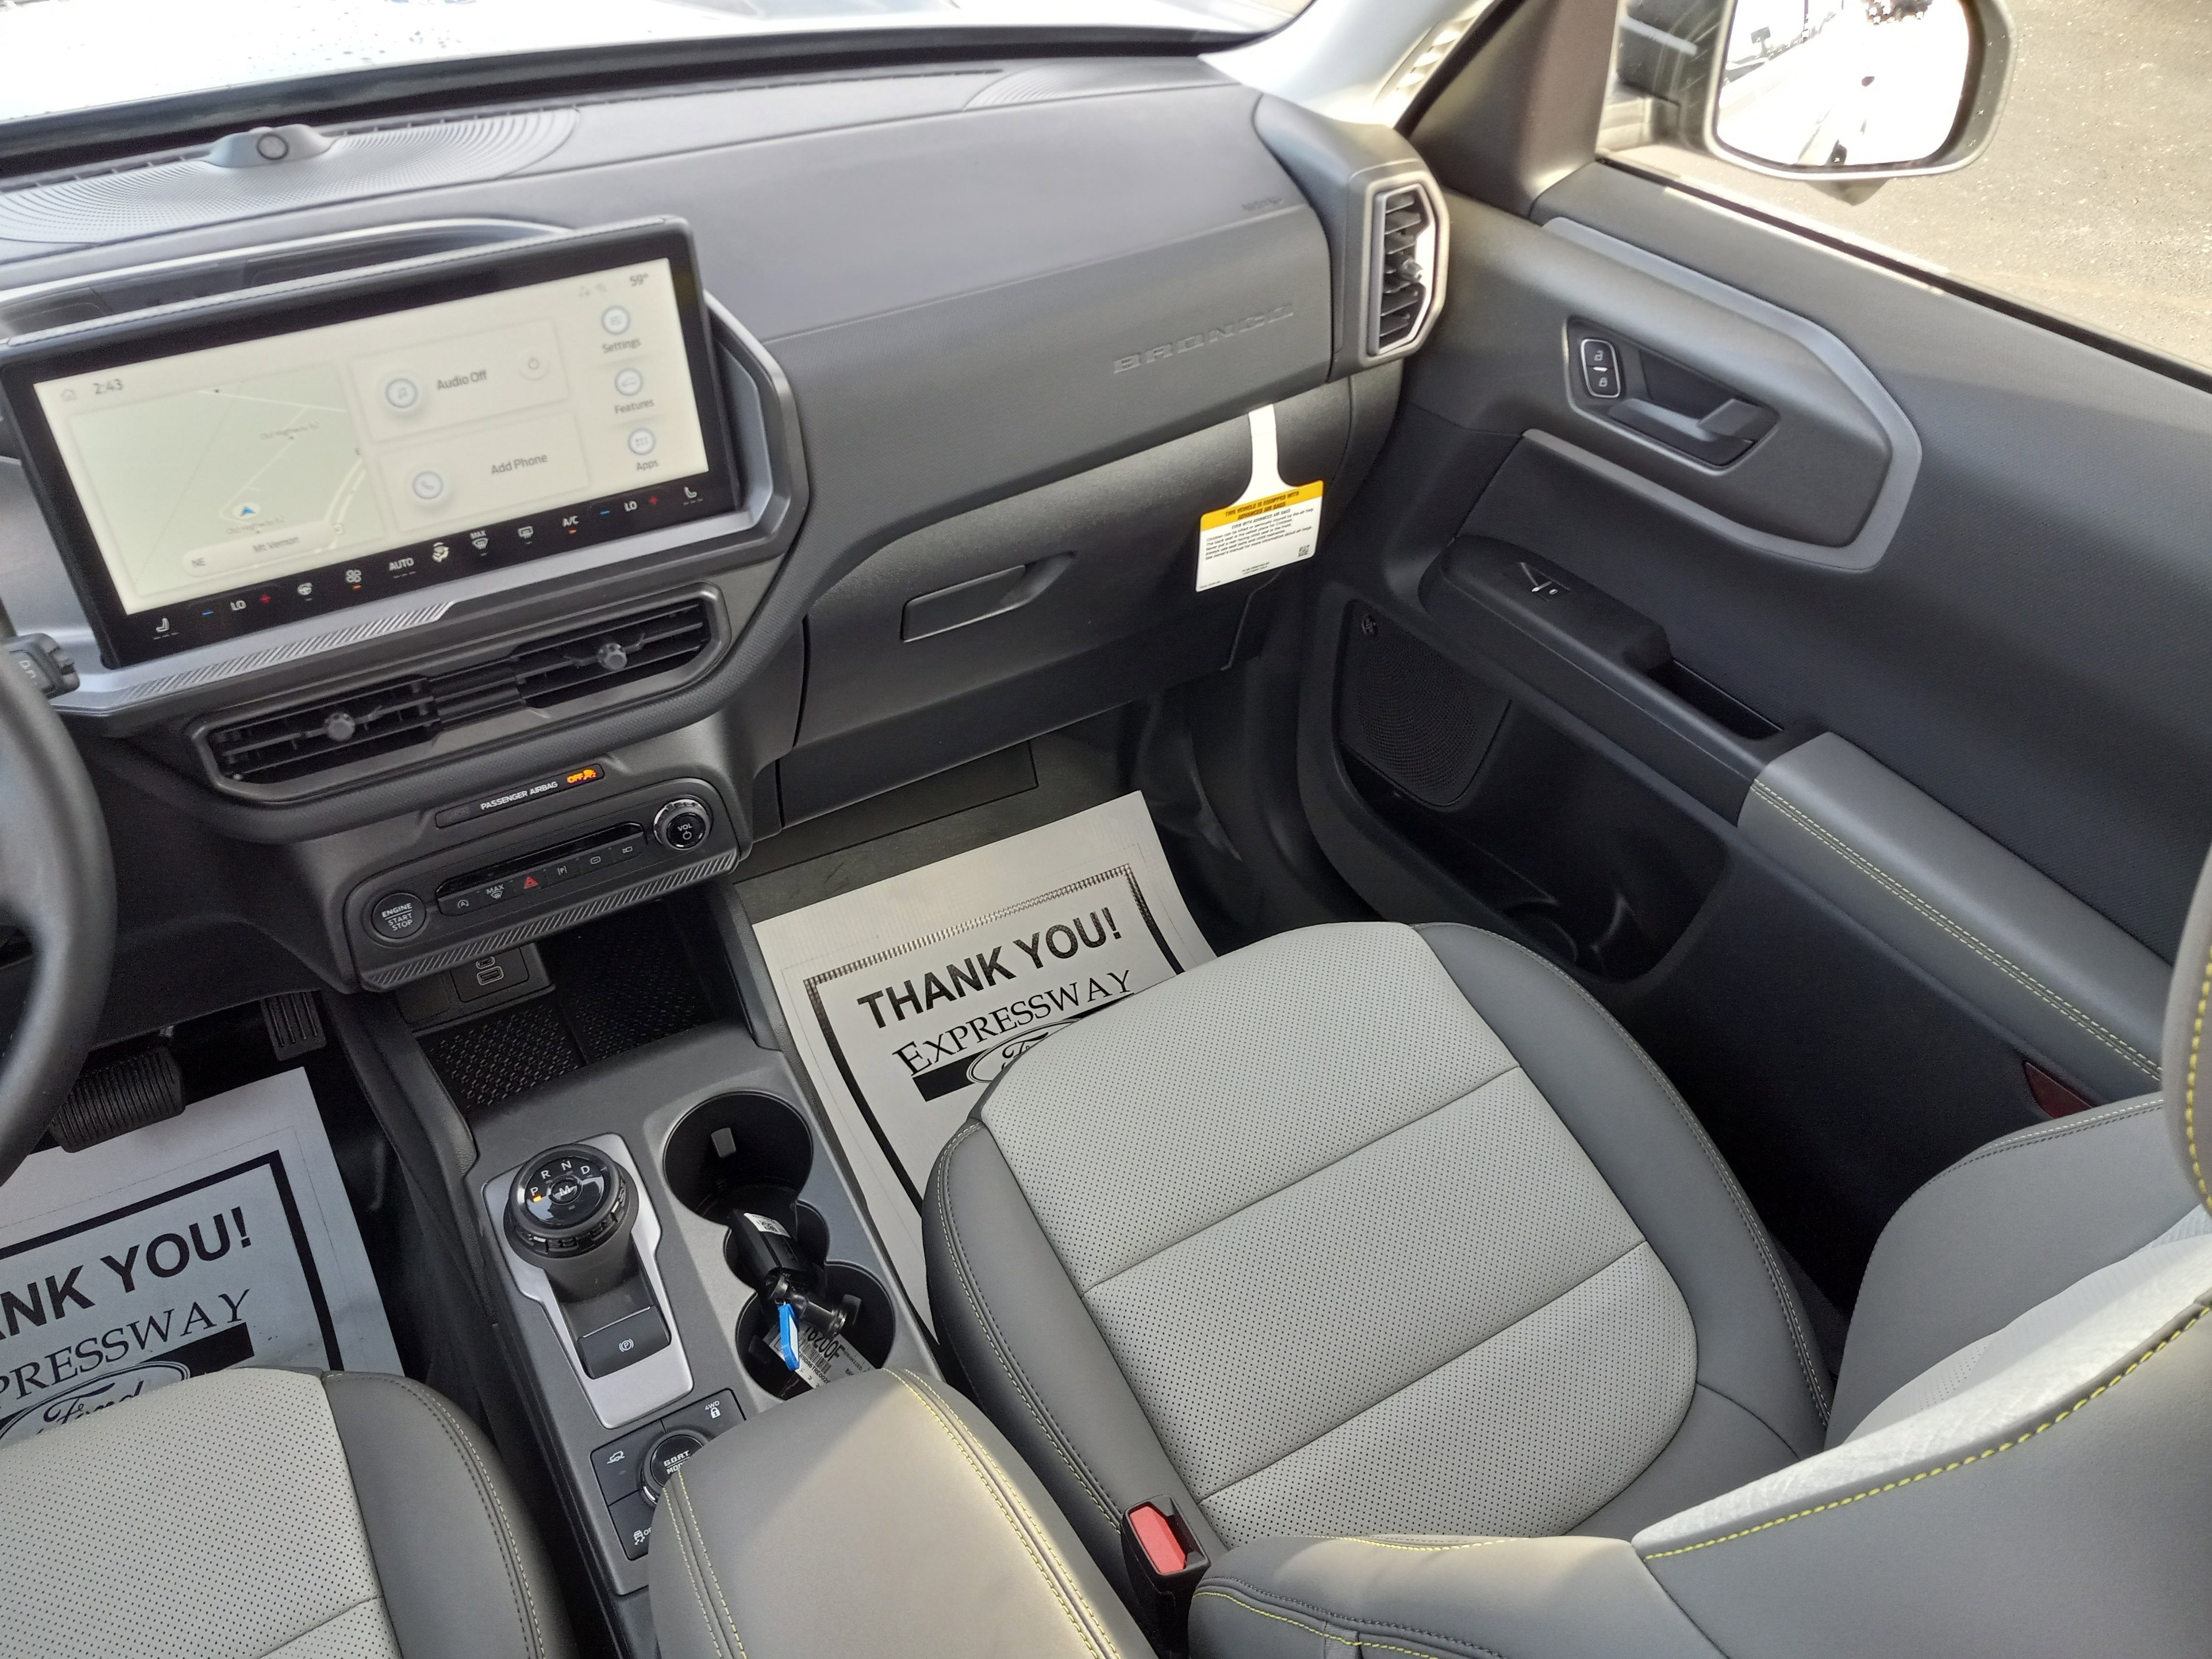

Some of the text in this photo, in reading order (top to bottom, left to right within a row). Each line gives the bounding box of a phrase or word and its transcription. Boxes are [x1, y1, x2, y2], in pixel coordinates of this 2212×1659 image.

[1113, 302, 1293, 374] BRONCO
[602, 338, 641, 354] Settings
[93, 379, 124, 395] 2:43
[437, 370, 488, 391] Audio Off
[614, 399, 654, 414] Features
[491, 453, 548, 475] Add Phone
[636, 459, 659, 472] Apps
[625, 500, 637, 512] LO
[1237, 504, 1256, 513] VEHICLE
[1263, 495, 1286, 505] EQUIPPED
[563, 516, 579, 527] A/C
[1238, 509, 1262, 520] ADVANCED
[470, 530, 487, 539] MAX
[389, 557, 414, 571] AUTO
[230, 600, 246, 611] LO
[481, 773, 583, 810] PASSENGER AIRBAG OFF
[677, 823, 693, 831] VOL
[486, 884, 505, 894] MAX
[382, 903, 412, 918] ENGINE
[388, 913, 412, 926] START
[392, 919, 413, 931] STOP
[857, 907, 1122, 1029] THANK YOU!
[891, 970, 1130, 1076] EXPRESSWAY
[530, 1161, 590, 1196] P R N D
[559, 1185, 571, 1196] M
[0, 1206, 252, 1340] NK YOU!
[705, 1401, 720, 1411] 4WD
[643, 1527, 652, 1536] OF
